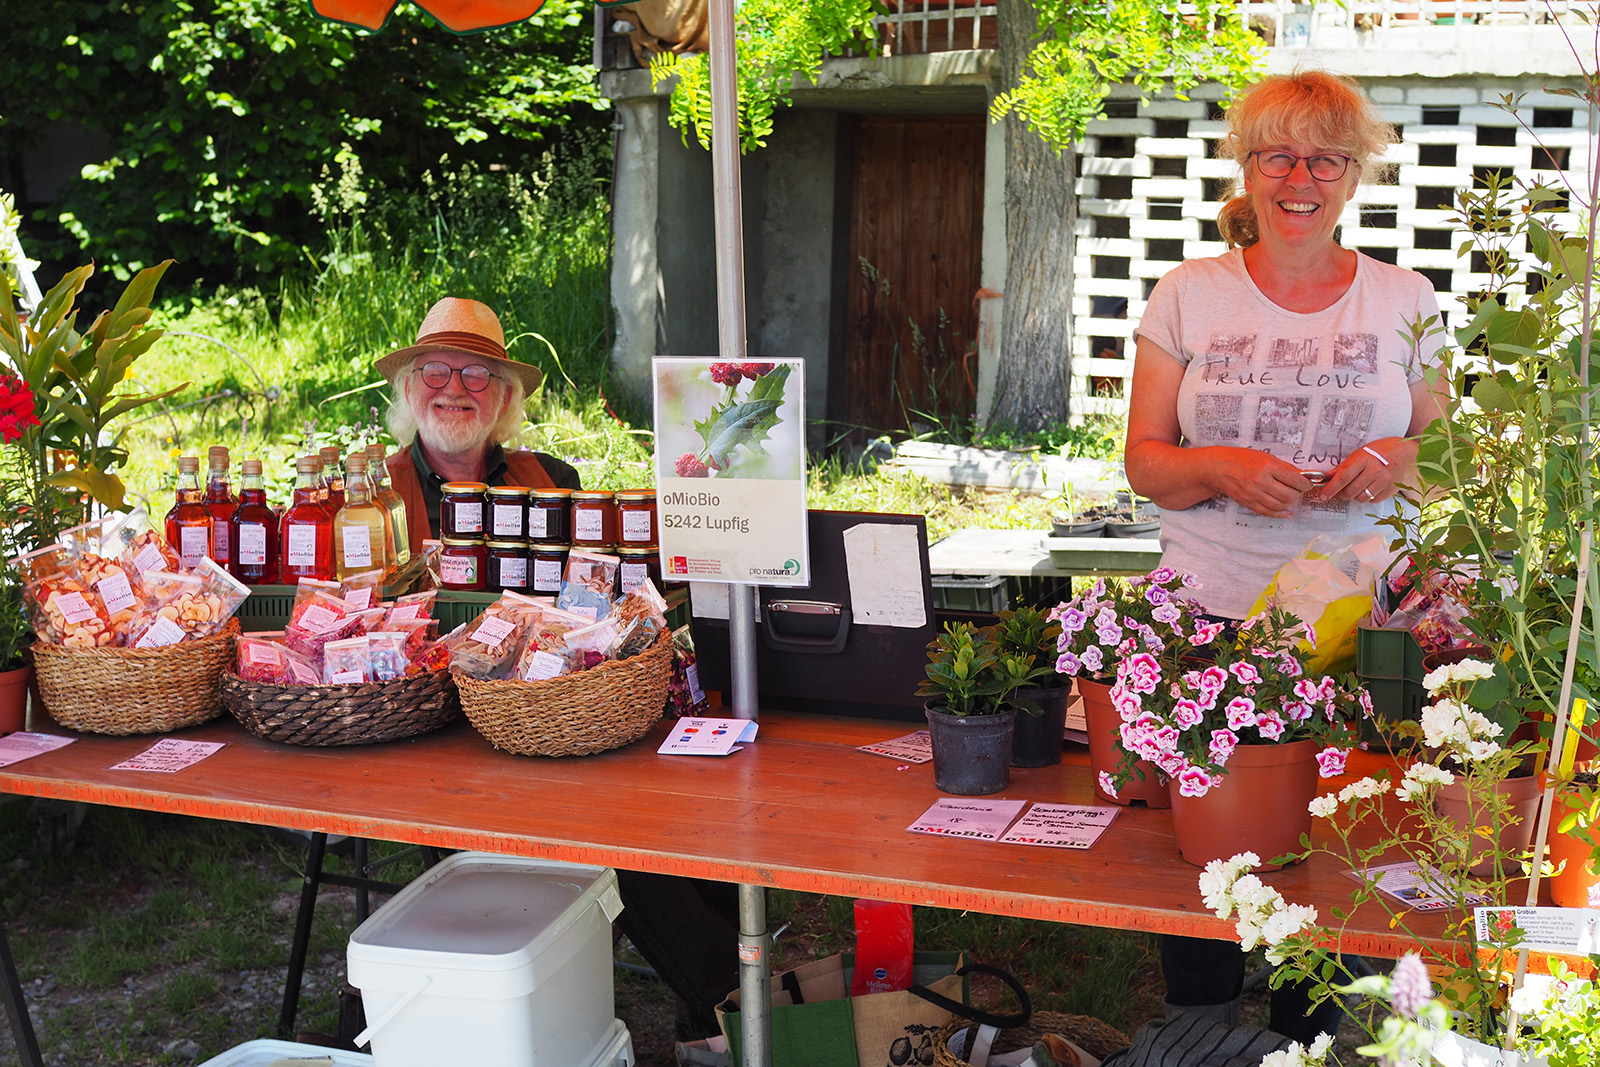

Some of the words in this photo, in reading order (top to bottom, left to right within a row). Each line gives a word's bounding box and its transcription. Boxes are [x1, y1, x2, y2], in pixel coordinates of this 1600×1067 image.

[1199, 357, 1274, 386] TRUE
[1296, 364, 1366, 389] LOVE
[663, 491, 720, 507] oMioBio
[664, 514, 702, 530] 5242
[706, 515, 750, 533] Lupfig
[749, 568, 762, 576] pro
[913, 826, 994, 838] oMioBio
[1005, 837, 1088, 847] oMioBio
